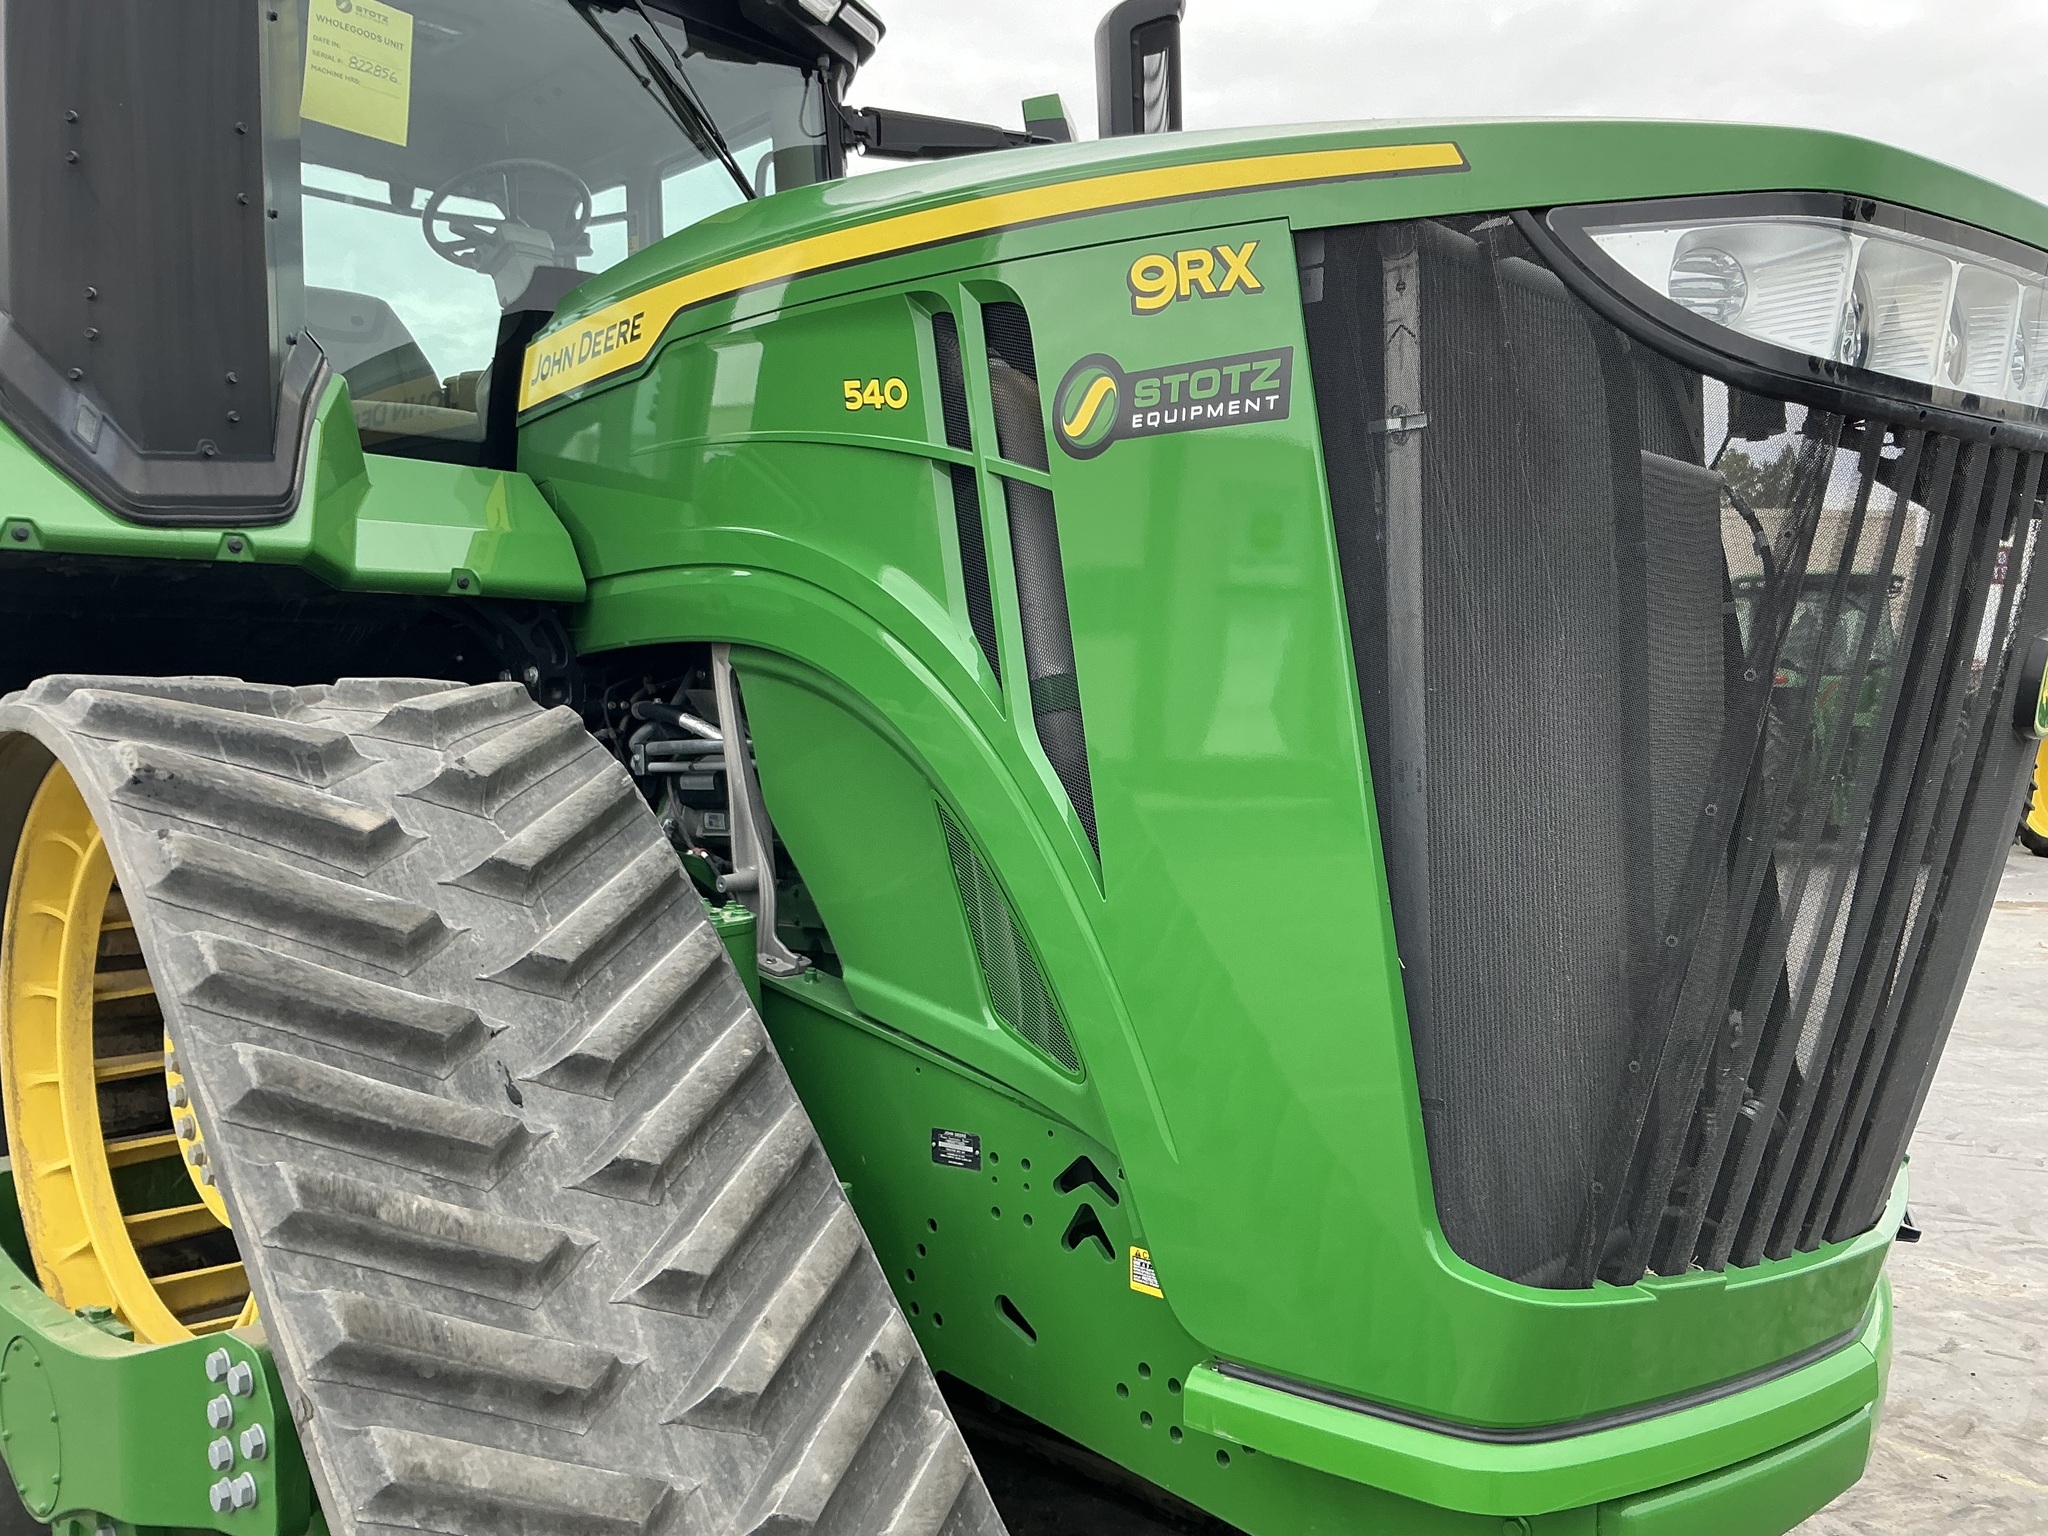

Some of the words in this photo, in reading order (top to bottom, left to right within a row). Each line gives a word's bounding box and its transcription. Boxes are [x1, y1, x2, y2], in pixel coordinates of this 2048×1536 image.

[355, 5, 389, 23] STOTZ
[312, 34, 331, 46] DATE
[331, 41, 341, 49] IN:
[315, 13, 383, 43] WHOLEGOODS
[384, 36, 405, 51] UNIT
[311, 49, 336, 63] SERIAL
[348, 55, 398, 84] 822856
[310, 64, 343, 79] MACHINE
[344, 75, 361, 85] HRS:
[1127, 239, 1265, 316] 9RX
[531, 342, 576, 387] JOHN
[577, 311, 645, 365] DEERE
[843, 376, 909, 411] 540
[1133, 358, 1282, 408] STOTZ
[1132, 394, 1280, 429] EQUIPMENT
